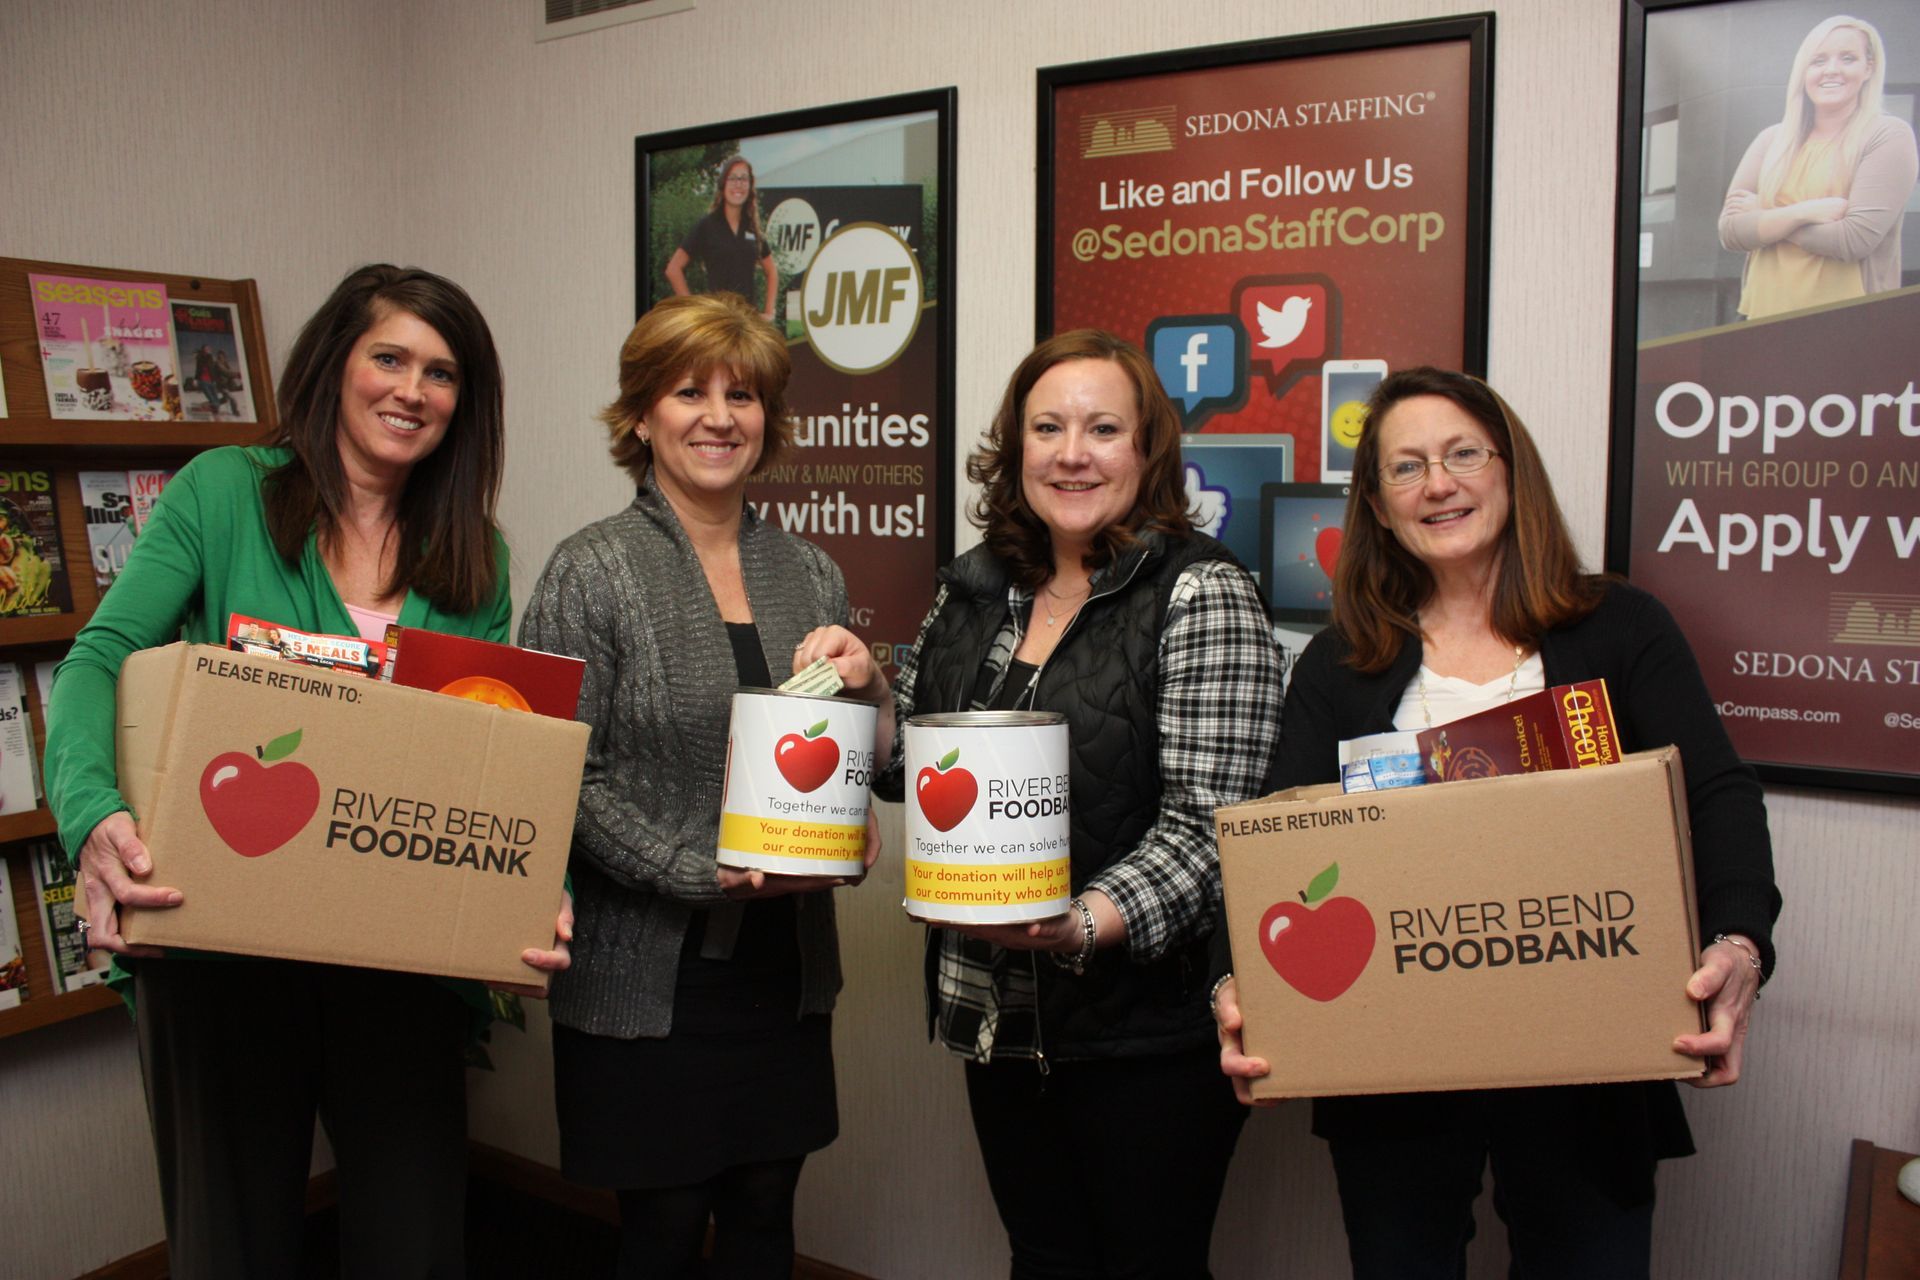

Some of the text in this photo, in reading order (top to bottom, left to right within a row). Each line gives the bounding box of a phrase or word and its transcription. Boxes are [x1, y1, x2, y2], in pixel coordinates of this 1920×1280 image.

[1185, 106, 1290, 138] SEDONA
[1099, 157, 1414, 211] Like and Follow Us
[1072, 206, 1445, 262] @SedonaStaffCorp
[36, 281, 163, 310] seasons
[809, 266, 911, 328] JMF
[42, 312, 61, 325] 47
[793, 402, 930, 447] unities
[801, 465, 813, 484] &
[816, 464, 860, 484] MANY
[862, 464, 924, 486] OTHERS
[1665, 461, 1733, 487] WITH
[1742, 460, 1840, 488] GROUP
[1849, 460, 1868, 488] O
[777, 491, 860, 534] with
[870, 494, 926, 538] us!
[1657, 498, 1871, 575] Apply
[293, 641, 303, 652] 5
[306, 644, 361, 662] MEALS
[1733, 651, 1876, 682] SEDONA
[196, 656, 363, 704] PLEASE RETURN TO:
[1513, 714, 1531, 767] Choice!
[989, 777, 1052, 798] RIVER
[332, 787, 537, 846] RIVER BEND
[768, 796, 827, 814] Together
[830, 805, 847, 816] we
[848, 806, 861, 816] can
[1220, 805, 1386, 838] PLEASE RETURN TO:
[760, 822, 788, 835] Your
[792, 826, 845, 840] donation
[916, 837, 969, 855] Together
[973, 843, 996, 854] we
[1000, 841, 1026, 854] can
[1029, 837, 1058, 852] solve
[326, 820, 532, 877] FOODBANK
[762, 843, 784, 854] our
[788, 844, 851, 860] community
[912, 865, 933, 880] Your
[936, 868, 997, 883] donation
[1002, 869, 1026, 882] will
[1030, 864, 1054, 881] help
[1056, 866, 1065, 877] us
[916, 887, 931, 898] our
[935, 890, 1011, 905] community
[1015, 886, 1042, 900] who
[1046, 883, 1058, 897] do
[1390, 890, 1635, 939] RIVER BEND
[1395, 924, 1640, 974] FOODBANK
